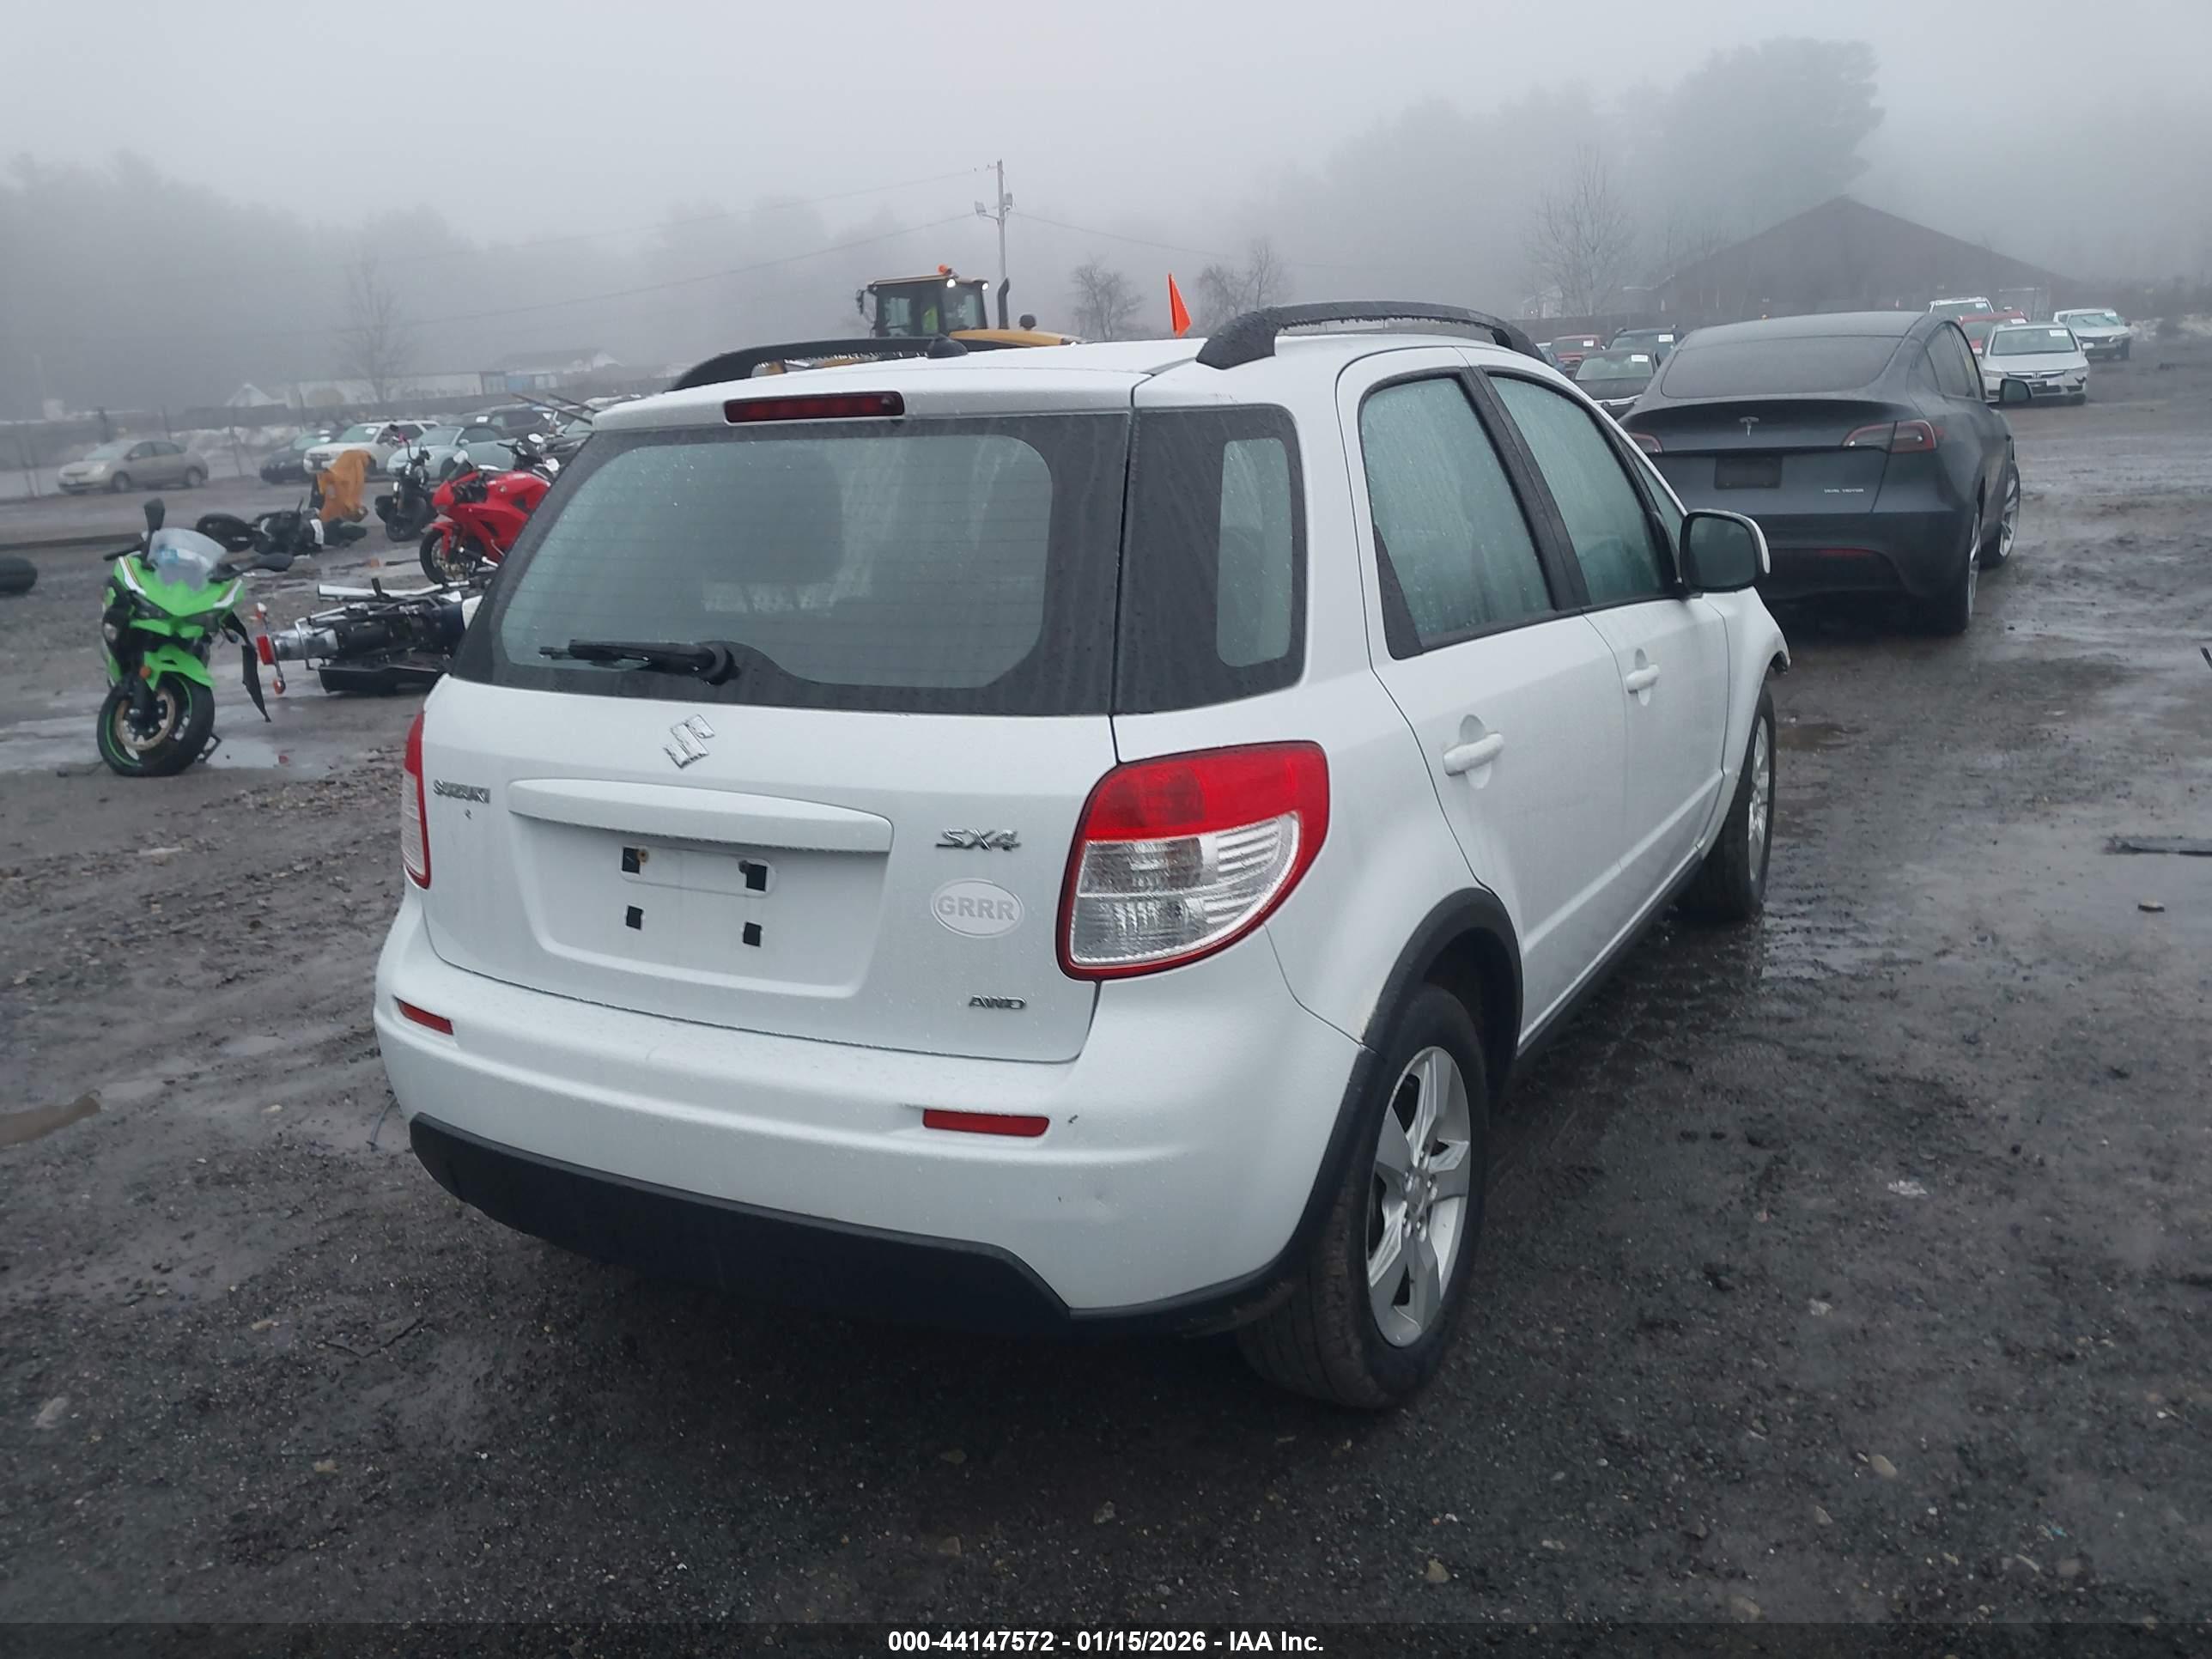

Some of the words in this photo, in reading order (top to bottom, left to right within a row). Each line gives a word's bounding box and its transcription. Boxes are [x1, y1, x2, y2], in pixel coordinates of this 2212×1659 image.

[935, 828, 1021, 851] SX4
[937, 895, 1017, 921] GRRR
[968, 994, 1027, 1009] AWD
